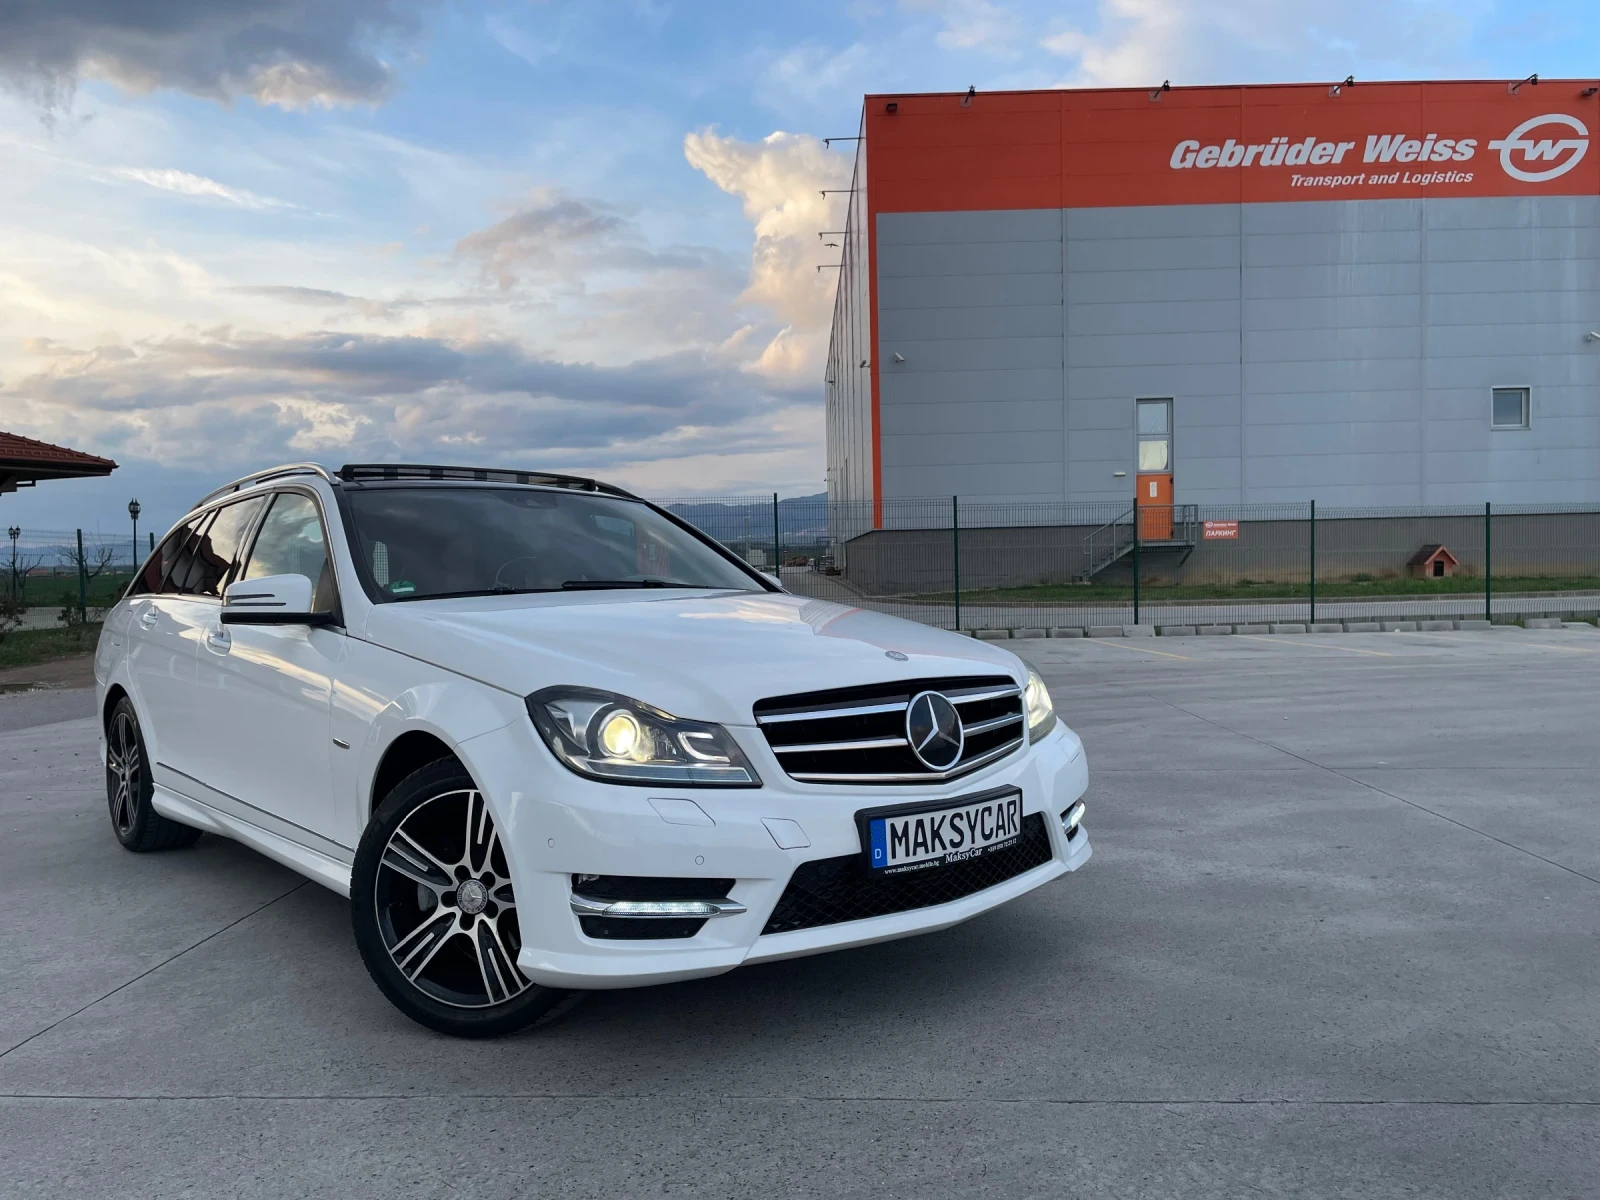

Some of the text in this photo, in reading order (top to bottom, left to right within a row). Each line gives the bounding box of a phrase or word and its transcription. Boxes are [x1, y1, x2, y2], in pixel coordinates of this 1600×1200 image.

[1170, 133, 1478, 169] Gebrüder Weiss
[1290, 170, 1473, 188] Transport and Logistics
[890, 800, 1018, 859] MAKSYCAR
[875, 848, 882, 860] D
[945, 848, 982, 863] MaksyCar
